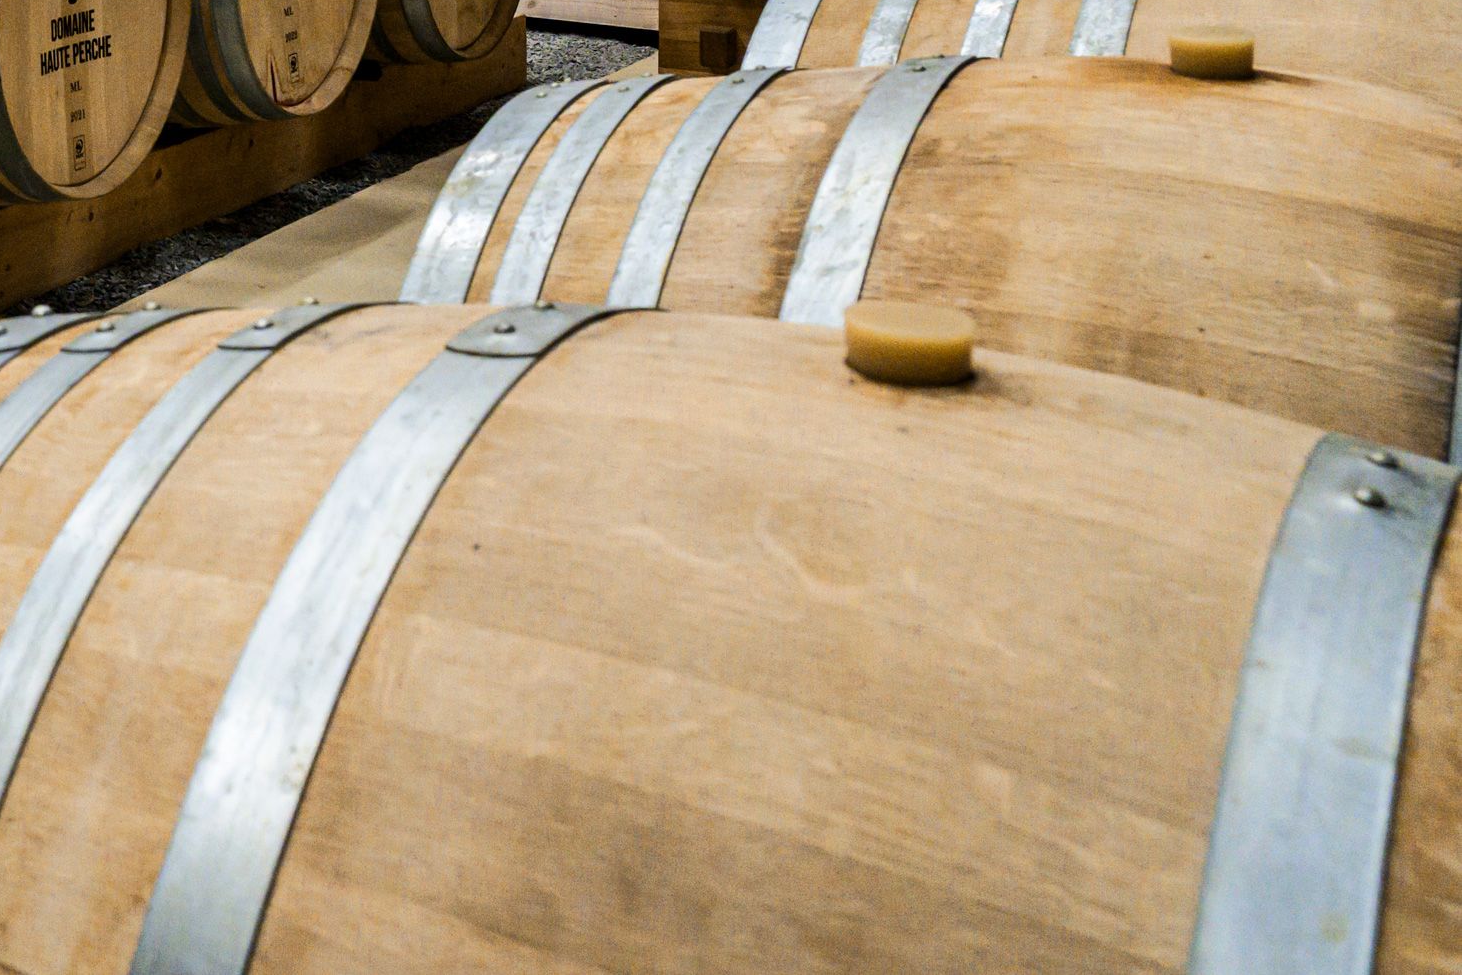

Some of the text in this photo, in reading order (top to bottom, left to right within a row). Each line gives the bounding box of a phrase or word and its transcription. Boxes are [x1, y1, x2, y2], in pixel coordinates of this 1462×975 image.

[50, 8, 95, 42] DOMAINE
[40, 34, 112, 77] HAUTE PERCHE
[70, 81, 82, 93] ML
